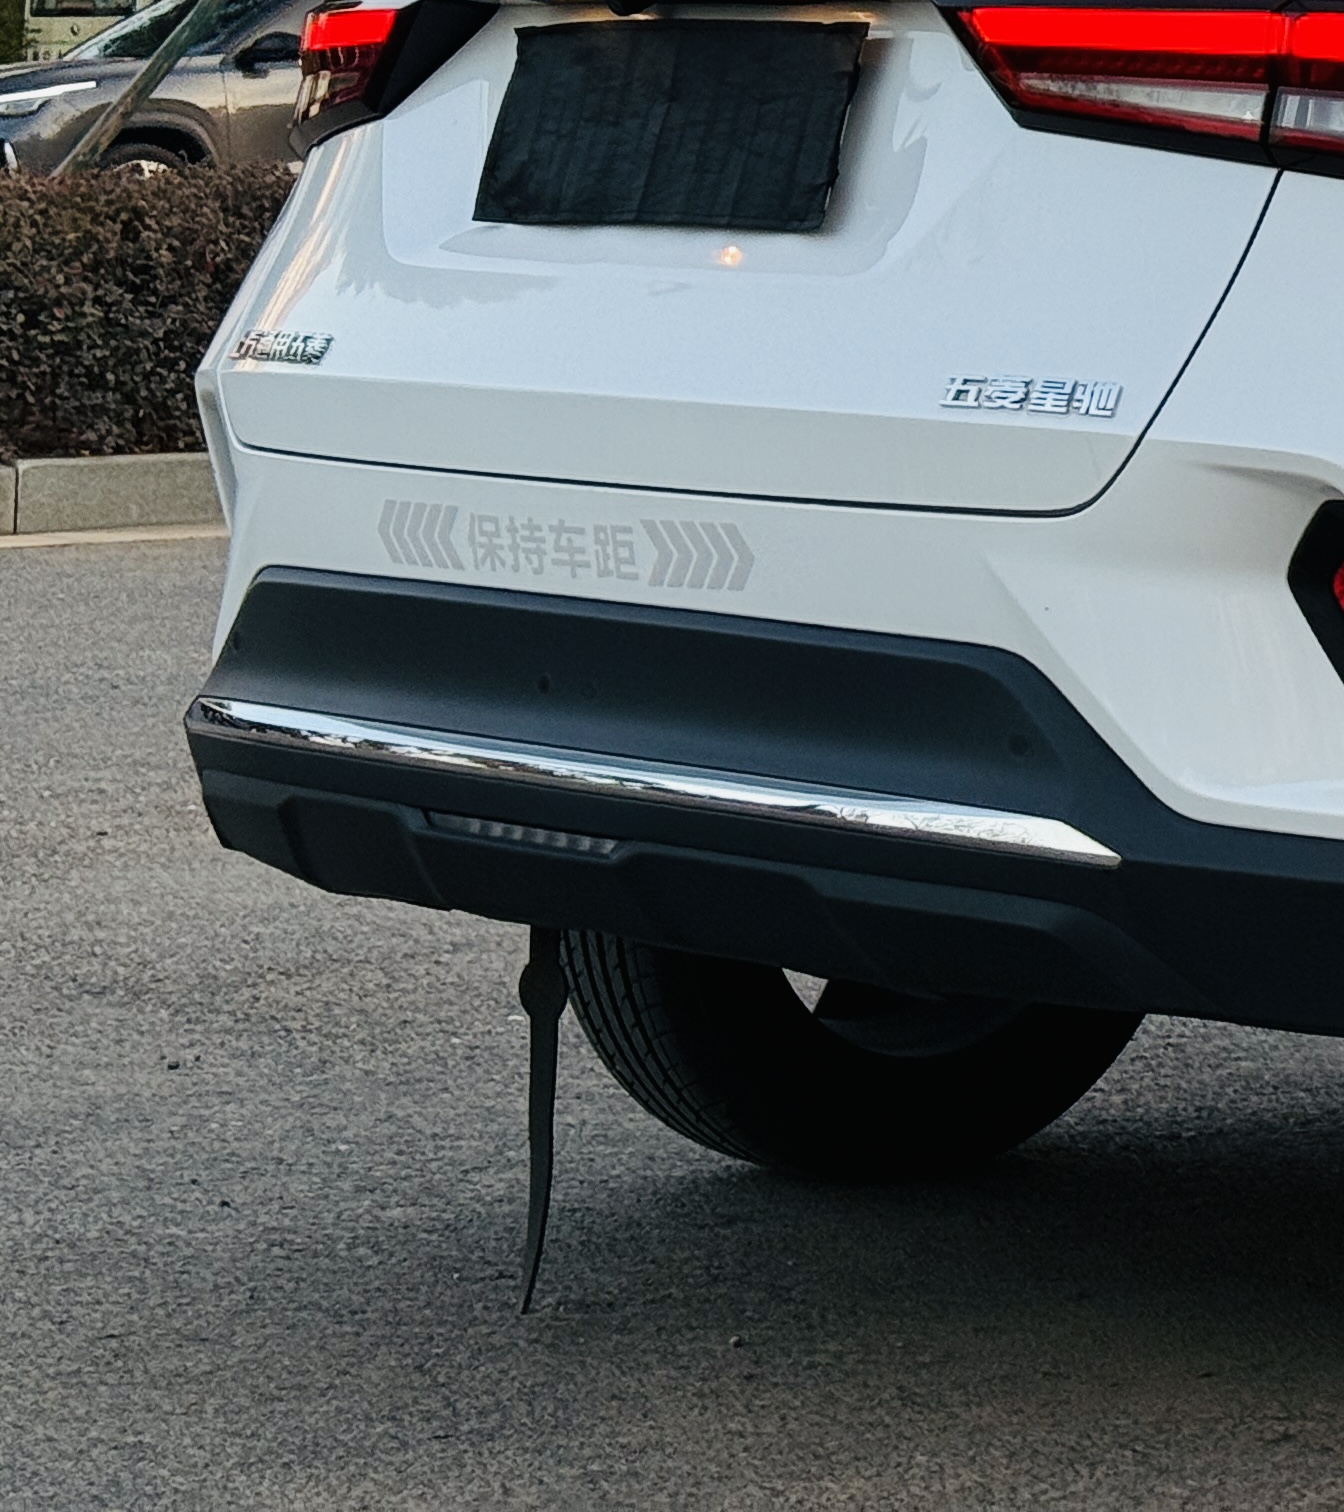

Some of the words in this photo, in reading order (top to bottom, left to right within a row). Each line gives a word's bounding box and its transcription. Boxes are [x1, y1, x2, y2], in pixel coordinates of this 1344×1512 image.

[938, 374, 1123, 419] 五菱星驰
[467, 511, 640, 581] 保持车距
